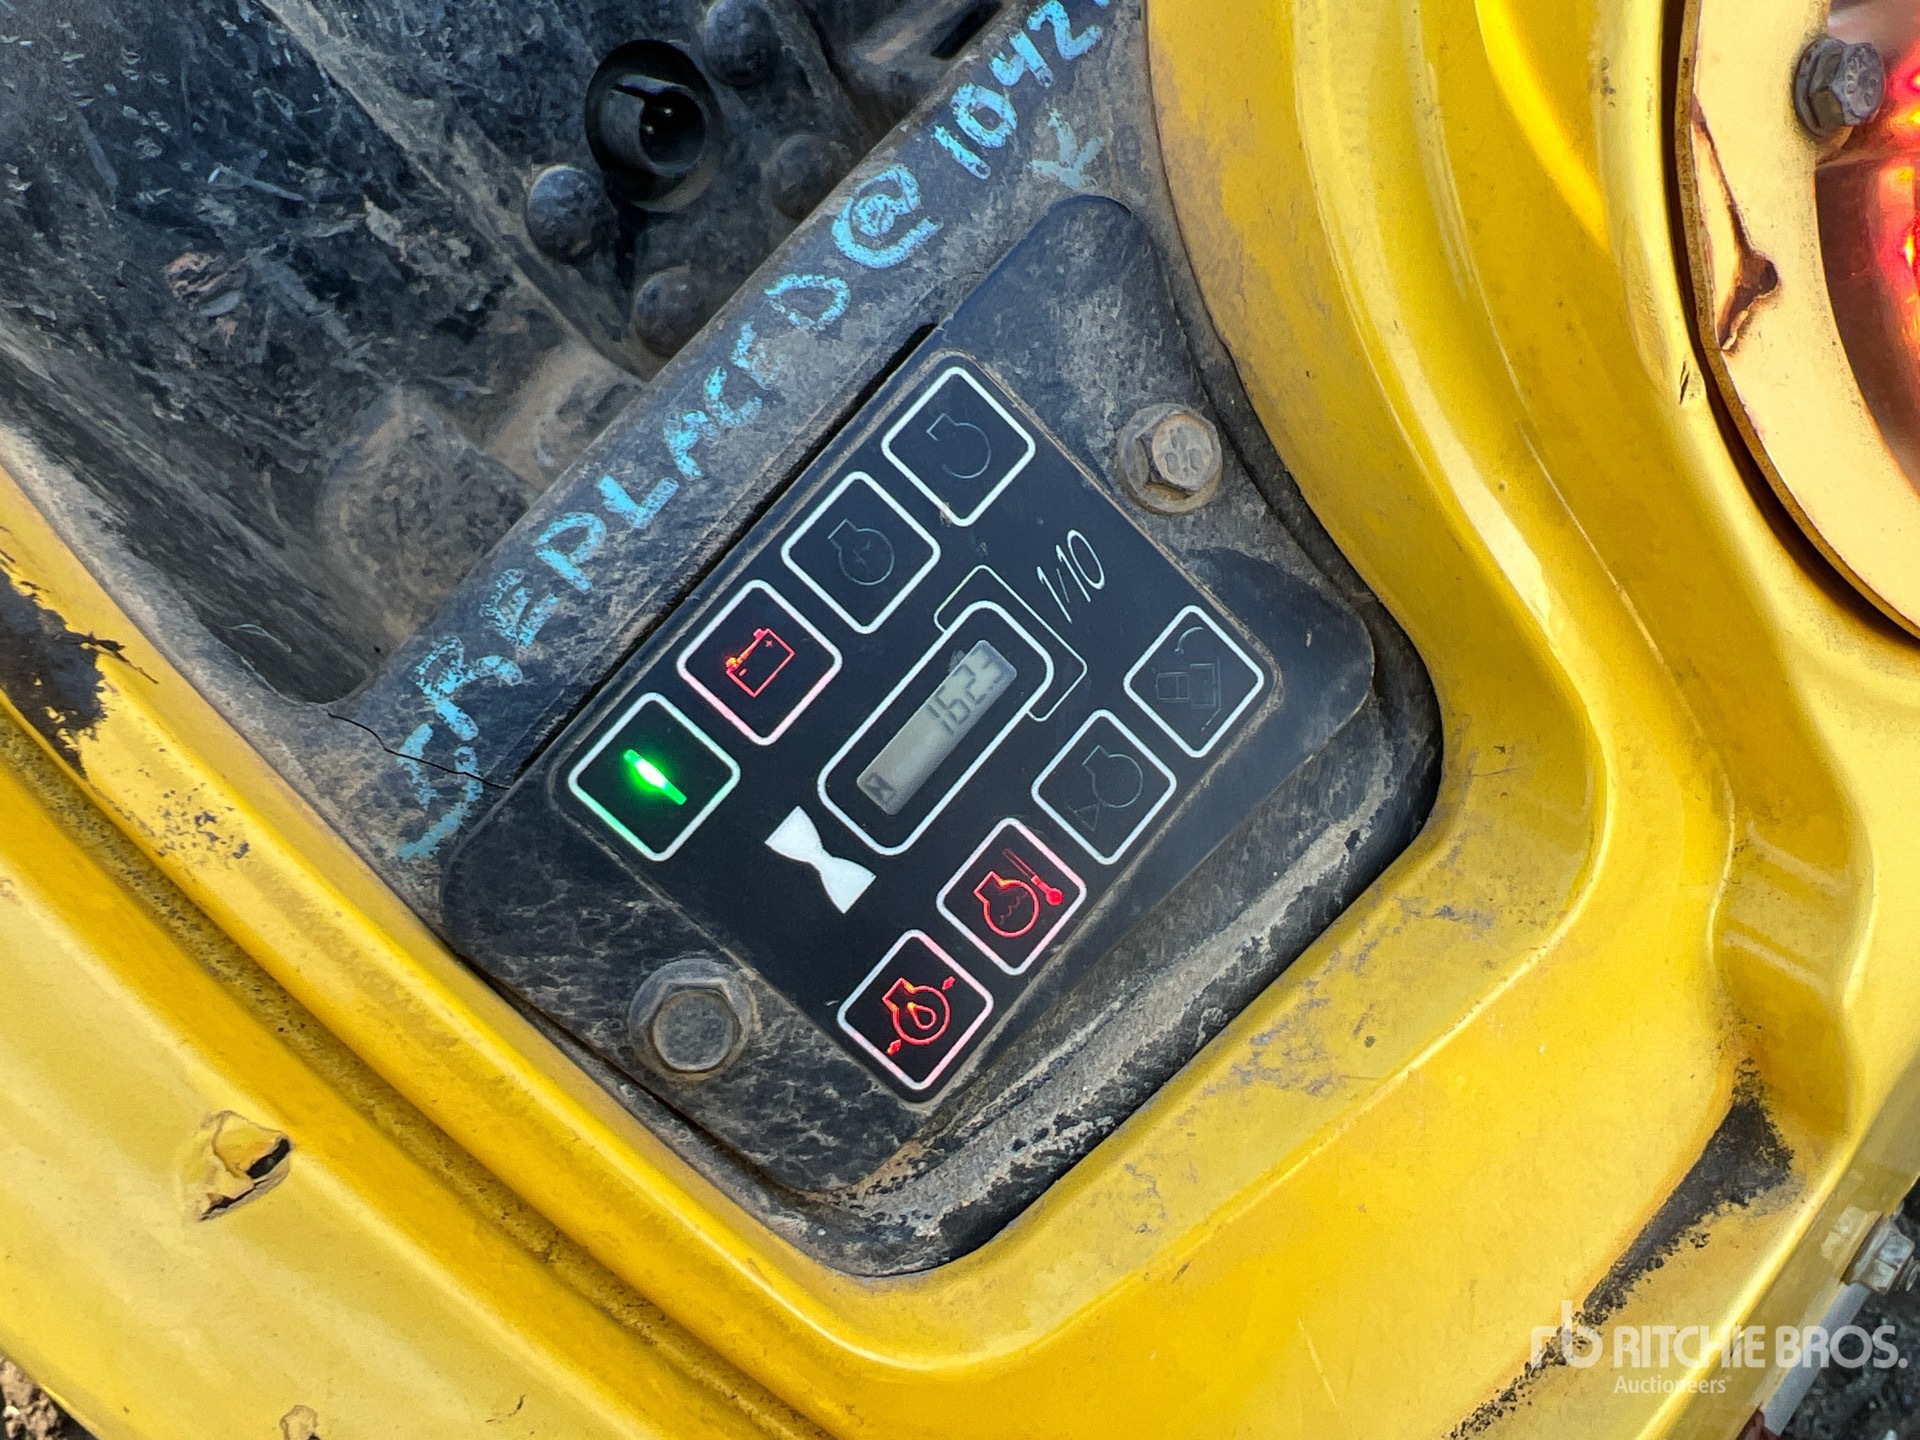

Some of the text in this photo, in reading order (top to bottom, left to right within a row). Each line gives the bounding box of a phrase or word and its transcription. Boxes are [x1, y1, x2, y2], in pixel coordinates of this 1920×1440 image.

[414, 0, 1110, 742] REPLACED @ 1042
[1036, 528, 1106, 624] 1/10
